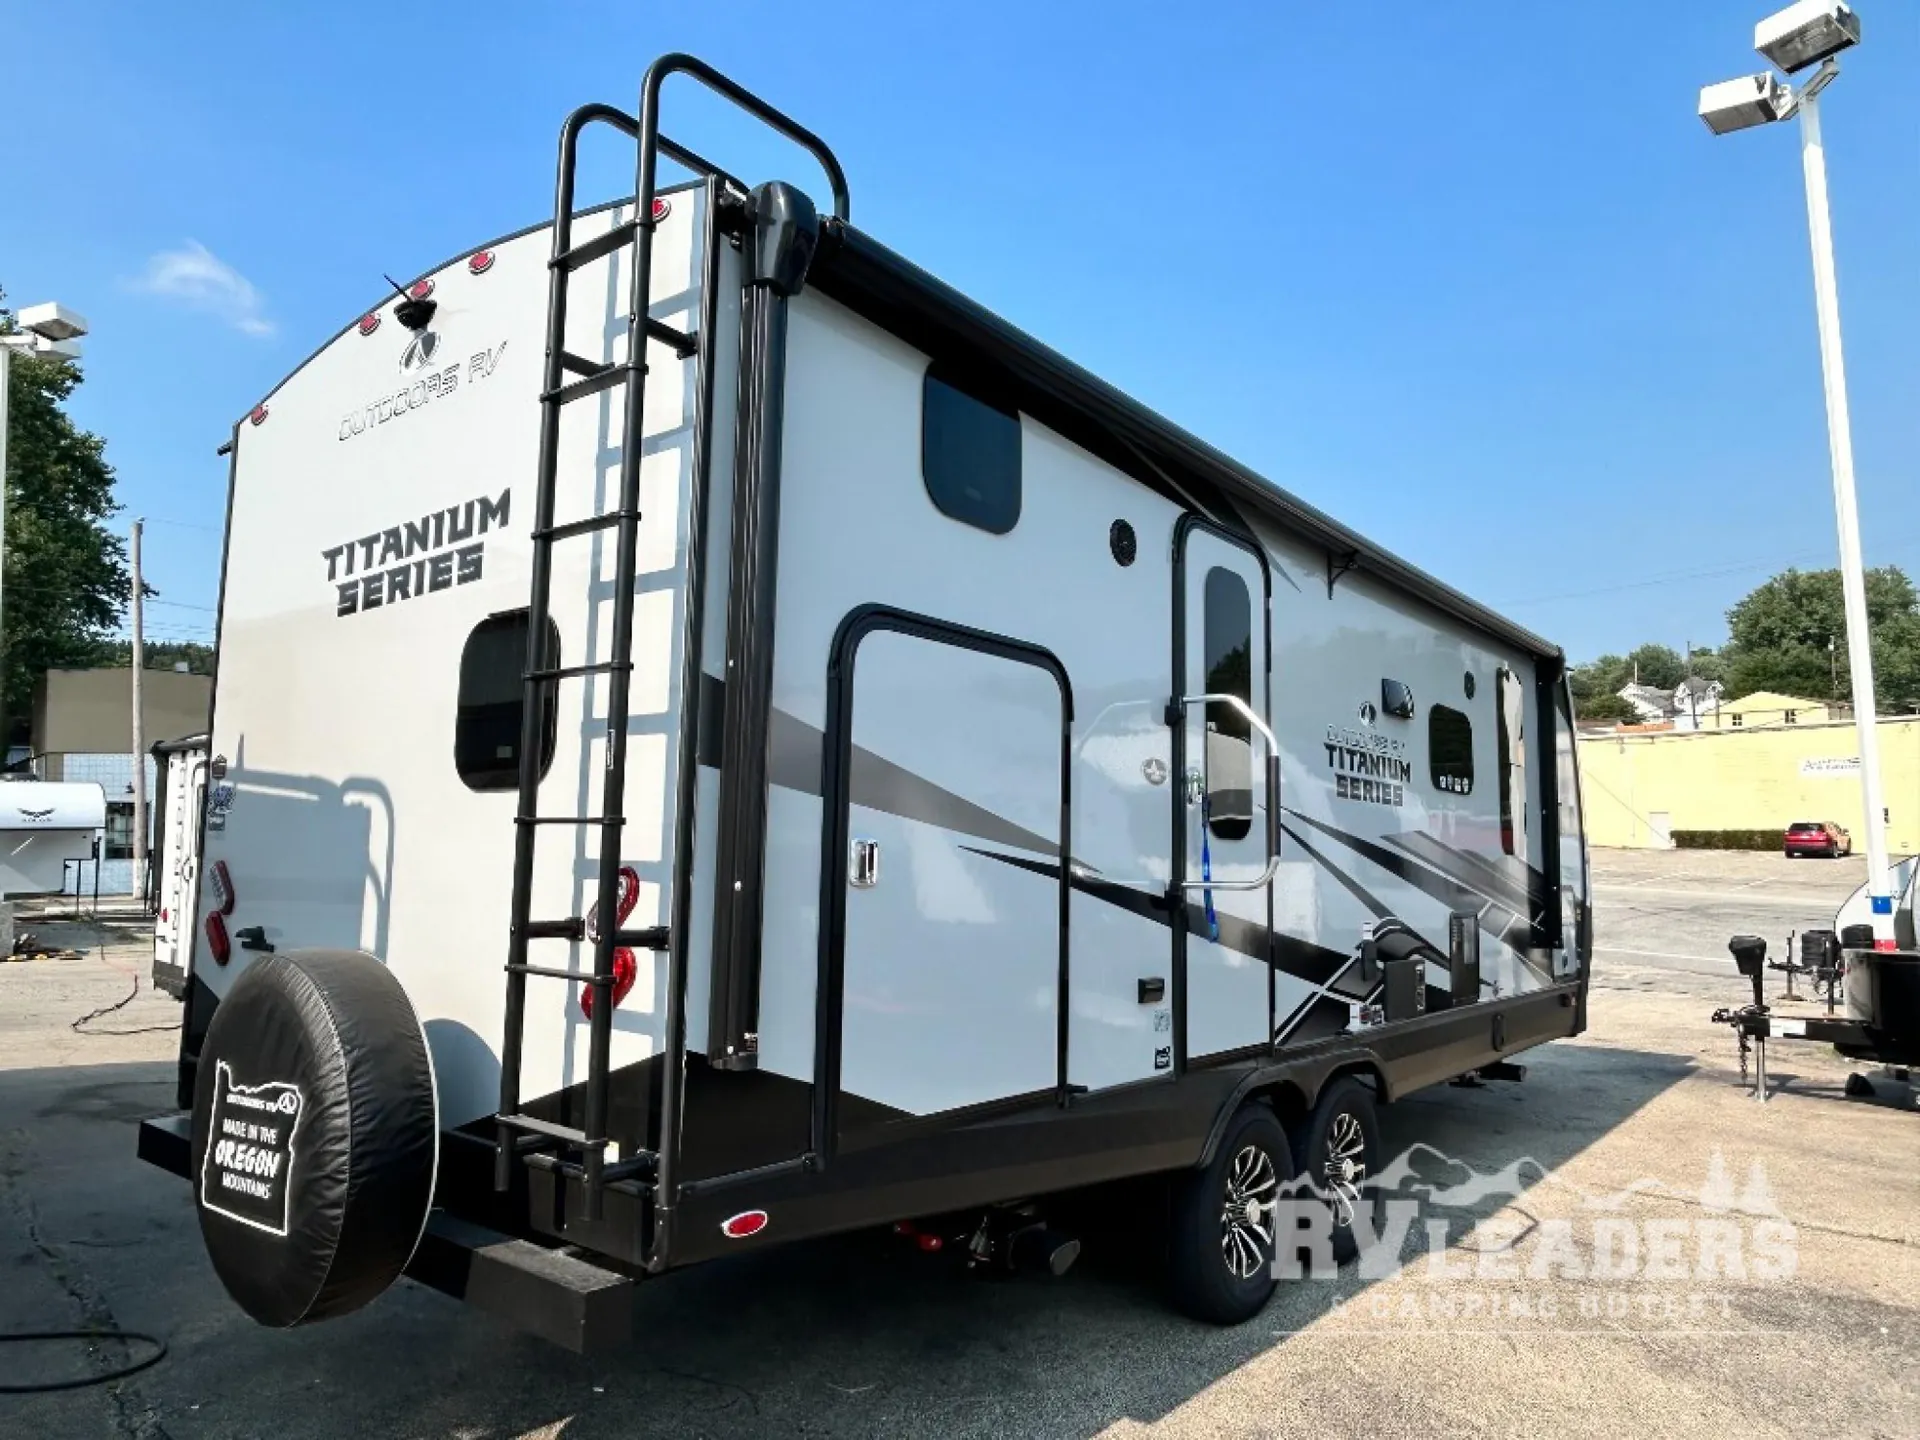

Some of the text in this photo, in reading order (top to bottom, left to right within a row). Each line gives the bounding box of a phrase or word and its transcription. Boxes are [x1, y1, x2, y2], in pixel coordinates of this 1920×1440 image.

[321, 487, 511, 582] TITANIUM
[335, 541, 485, 618] SERIES
[1323, 742, 1411, 783] TITANIUM
[1335, 772, 1403, 807] SERIES
[223, 1118, 279, 1145] MADE IN THE
[215, 1139, 280, 1178] OREGON
[222, 1171, 272, 1199] MOUNTAINS
